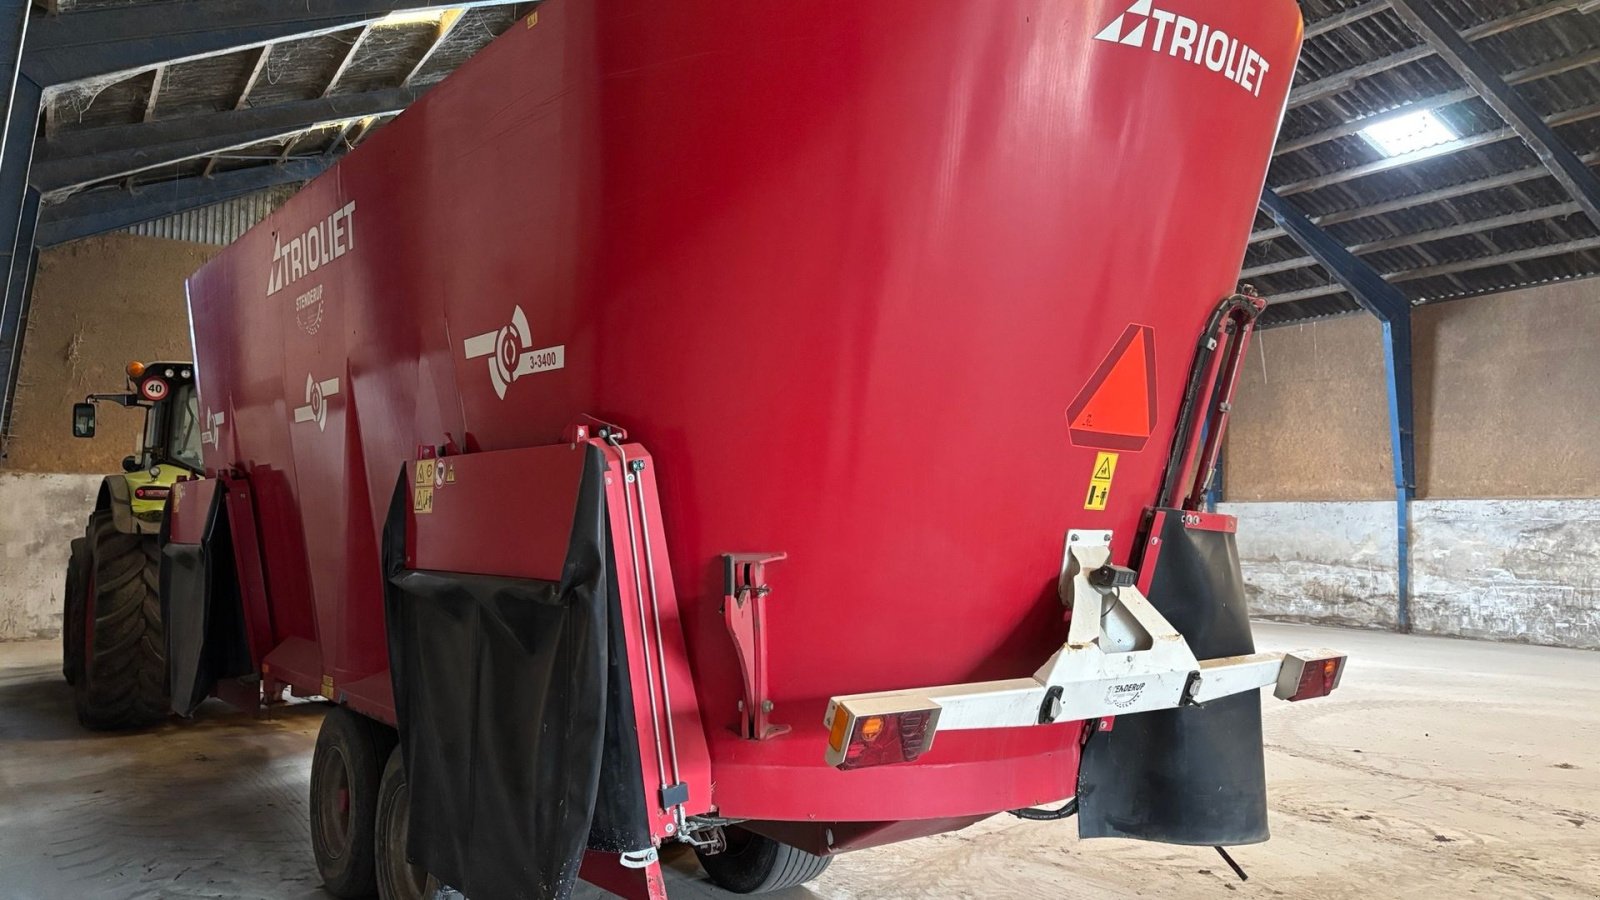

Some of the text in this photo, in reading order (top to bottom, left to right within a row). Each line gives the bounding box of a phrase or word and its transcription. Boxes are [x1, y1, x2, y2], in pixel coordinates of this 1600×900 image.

[1152, 8, 1270, 98] TRIOLIET
[281, 200, 356, 287] TRIOLIET
[530, 351, 556, 369] 3-3400
[148, 384, 162, 393] 40
